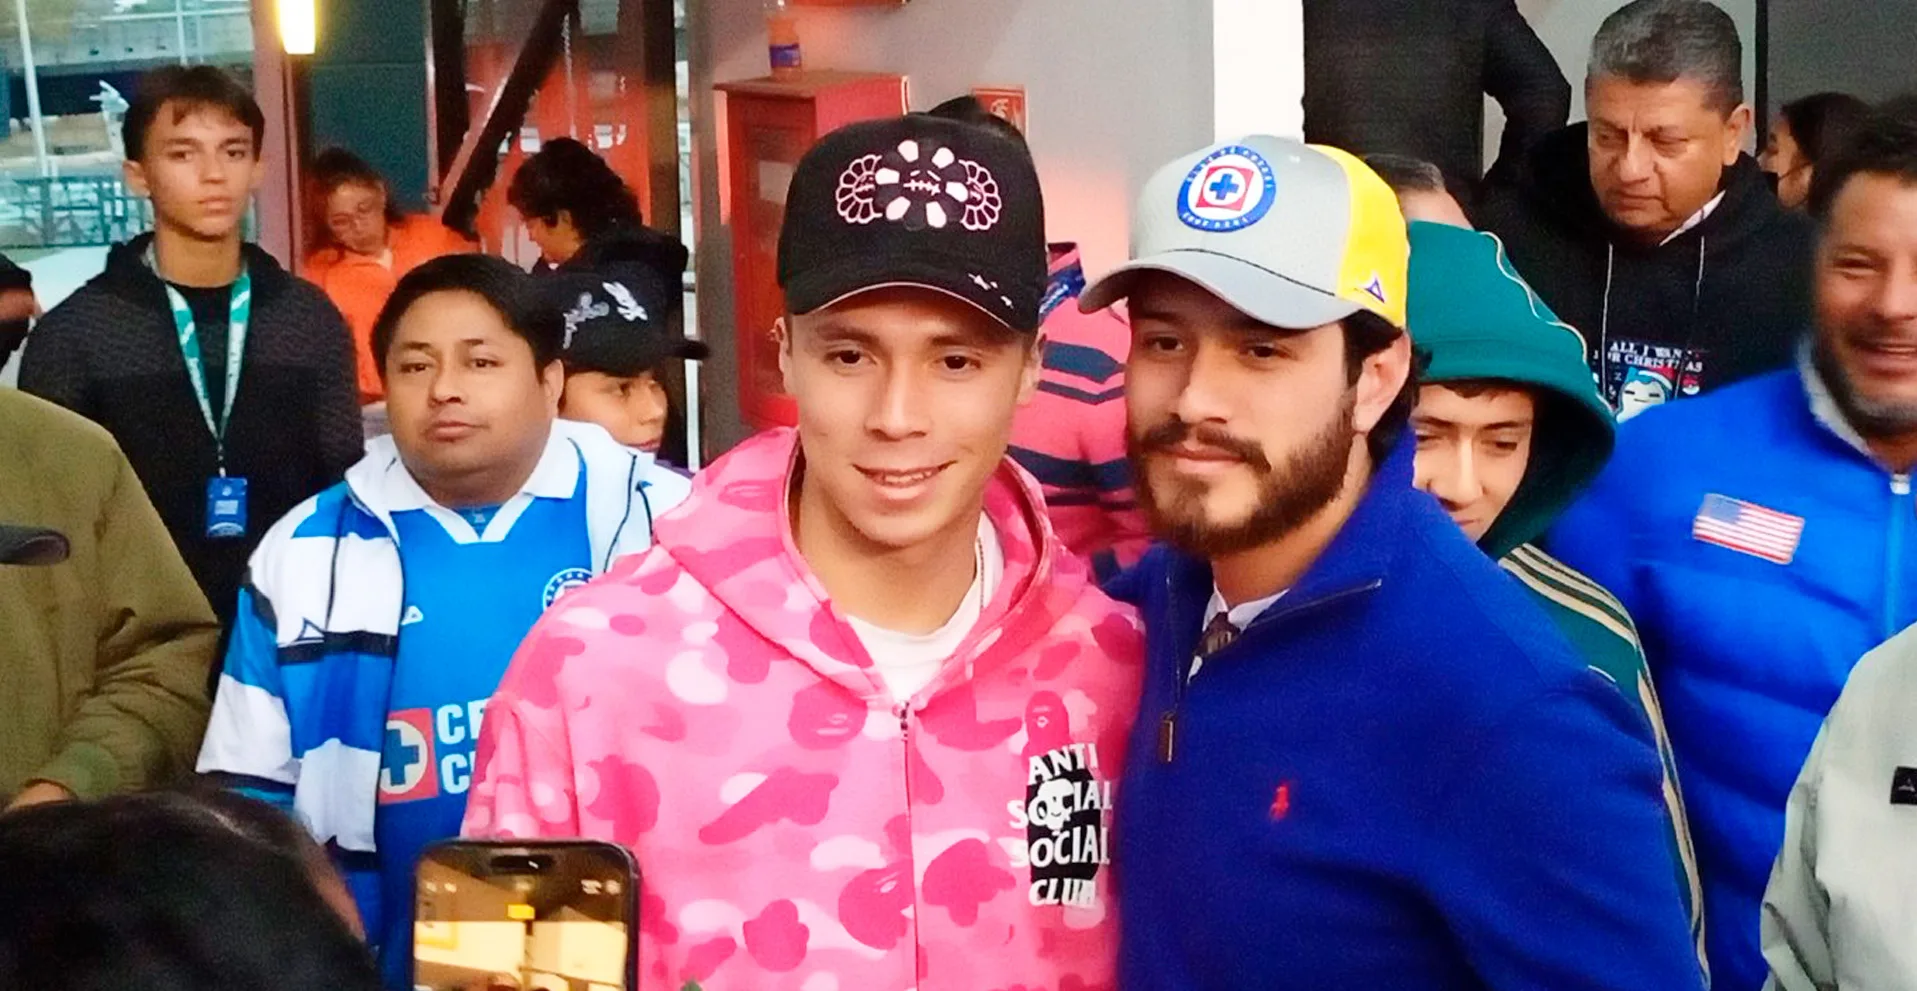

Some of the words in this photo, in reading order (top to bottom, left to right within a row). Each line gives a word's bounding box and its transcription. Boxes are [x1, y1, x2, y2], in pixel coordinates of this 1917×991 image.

[1610, 341, 1637, 354] ALL
[1655, 346, 1692, 360] WAN
[1624, 354, 1702, 373] CHRISTAS
[1028, 742, 1098, 786] ANTI
[1007, 780, 1112, 829] SOCIAL
[1007, 824, 1110, 869] SOCIAL
